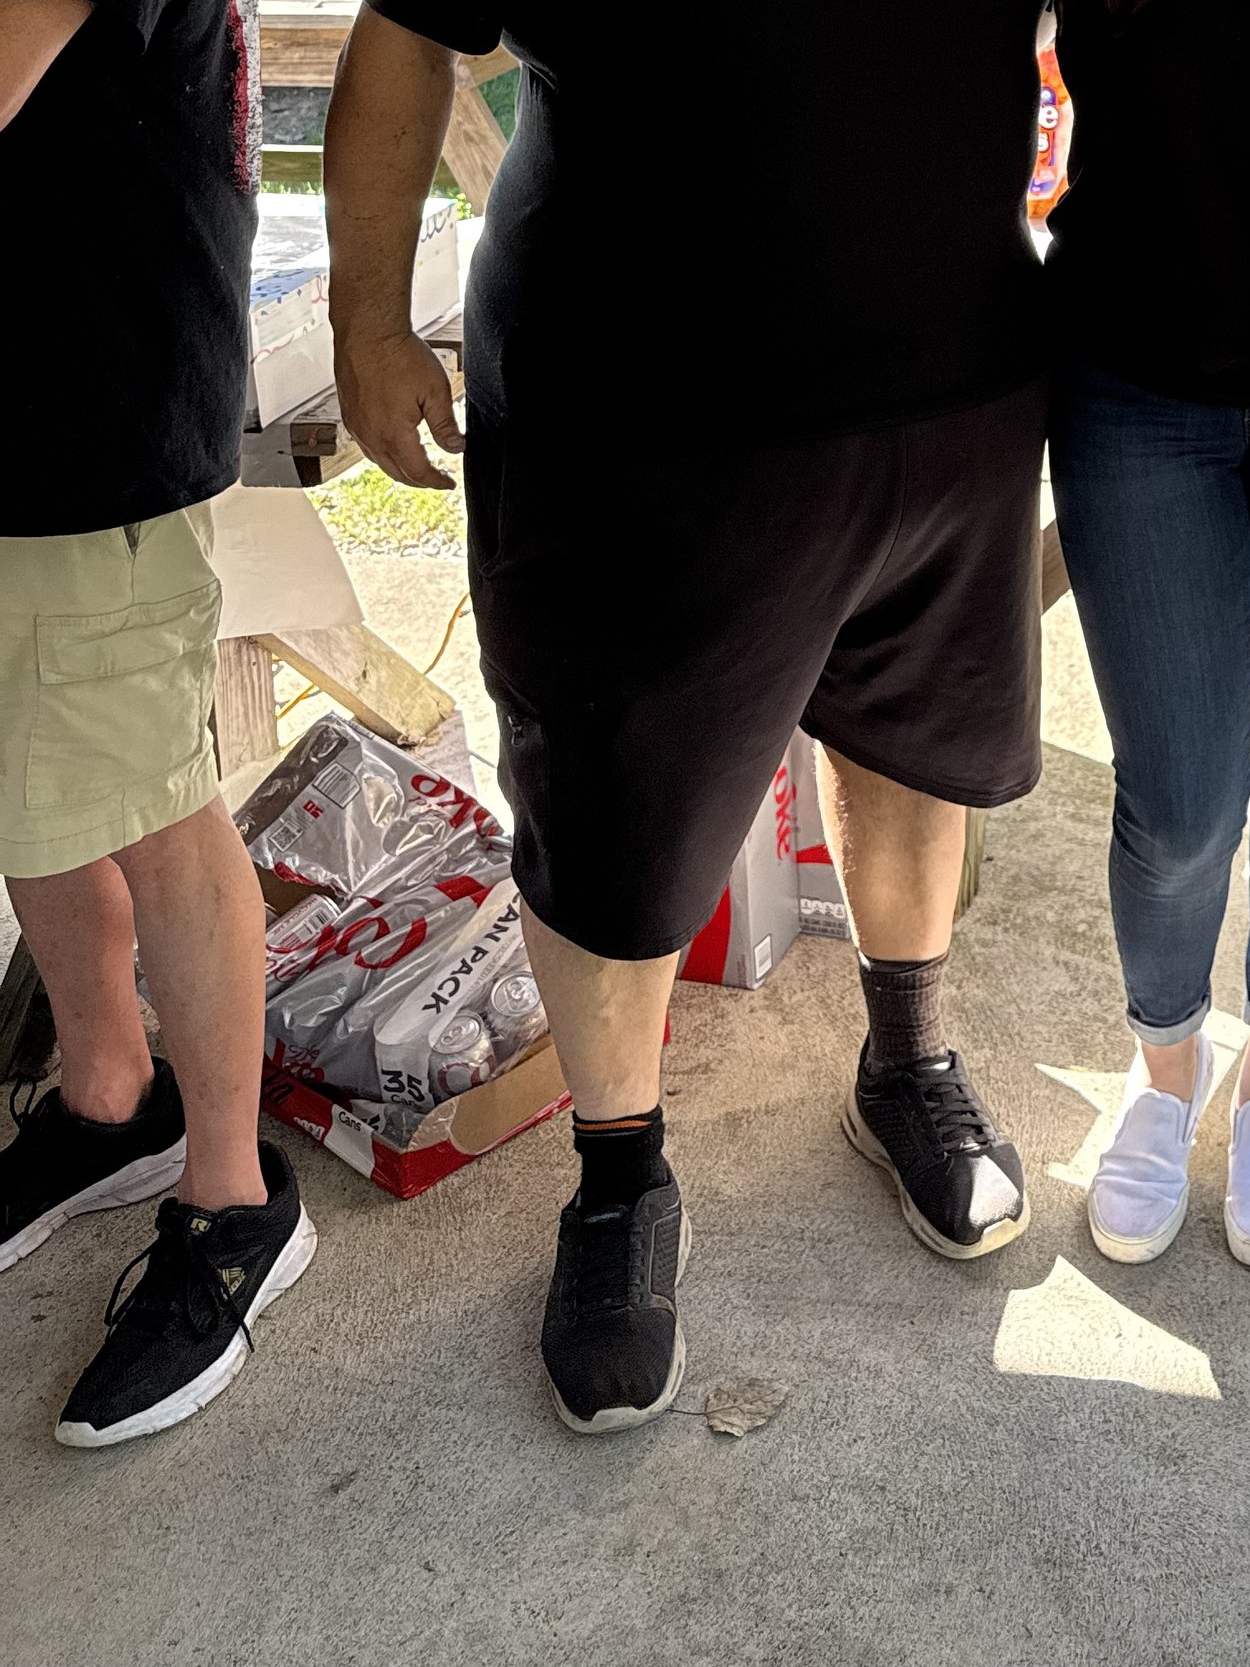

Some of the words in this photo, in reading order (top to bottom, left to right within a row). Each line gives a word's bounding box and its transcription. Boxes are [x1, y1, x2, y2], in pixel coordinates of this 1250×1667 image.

[421, 945, 490, 1014] PACK
[380, 1068, 426, 1103] 35
[338, 1111, 362, 1132] Cans
